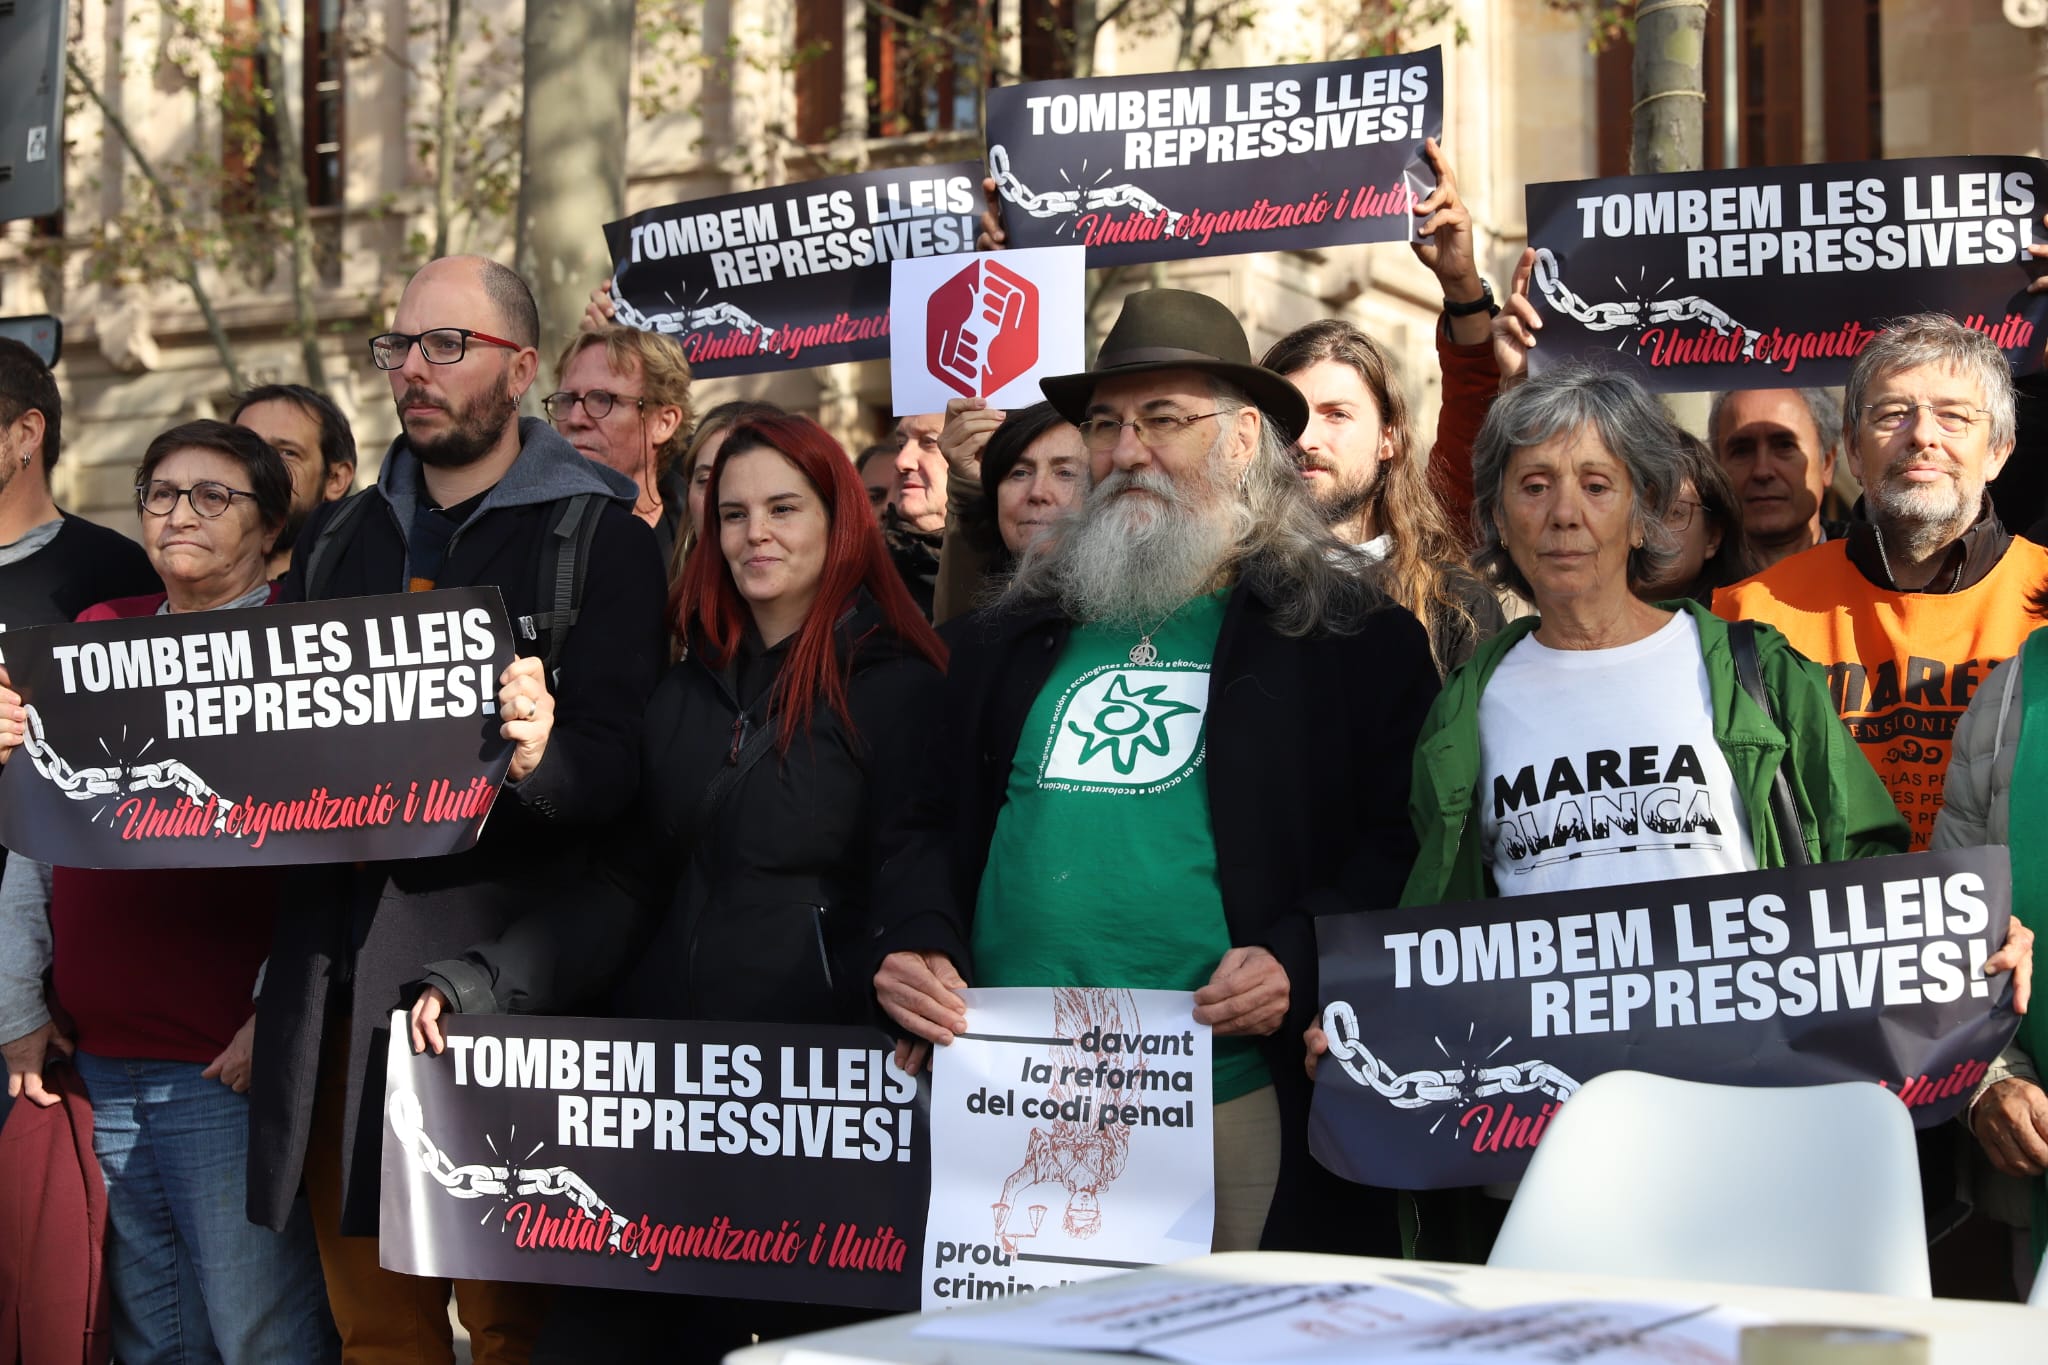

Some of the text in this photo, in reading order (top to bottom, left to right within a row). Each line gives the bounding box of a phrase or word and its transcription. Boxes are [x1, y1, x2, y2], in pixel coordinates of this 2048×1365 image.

[1026, 65, 1428, 136] TOMBEM LES LLEIS
[1124, 104, 1424, 170] REPRESSIVES!
[630, 176, 974, 264] TOMBEM LES LLEIS
[1174, 191, 1330, 246] organització
[1334, 189, 1350, 219] i
[1577, 171, 2035, 239] TOMBEM LES LLEIS
[710, 215, 974, 289] REPRESSIVES!
[1688, 218, 2033, 280] REPRESSIVES!
[768, 306, 890, 360] organitzaci
[1753, 320, 1885, 373] organitz
[53, 630, 253, 694] TOMBEM
[266, 621, 353, 676] LES
[365, 608, 495, 668] LLEIS
[1823, 656, 2002, 712] MARE
[165, 664, 496, 739] REPRESSIVES!
[226, 782, 400, 848] organització
[403, 781, 420, 823] i
[423, 775, 495, 823] lluita
[1493, 744, 1707, 819] MAREA
[1497, 787, 1722, 860] BLANCA
[1384, 872, 1989, 989] TOMBEM LES LLEIS
[1531, 939, 1990, 1038] REPRESSIVES!
[446, 1036, 918, 1104] TOMBEM LES LLEIS
[1021, 1057, 1193, 1092] la reforma
[1080, 1026, 1194, 1056] davant
[557, 1095, 912, 1162] REPRESSIVES!
[966, 1087, 1194, 1130] del codi penal
[620, 1211, 806, 1272] organització
[808, 1223, 826, 1265] i
[827, 1224, 908, 1272] lluita
[935, 1240, 1012, 1269] prou
